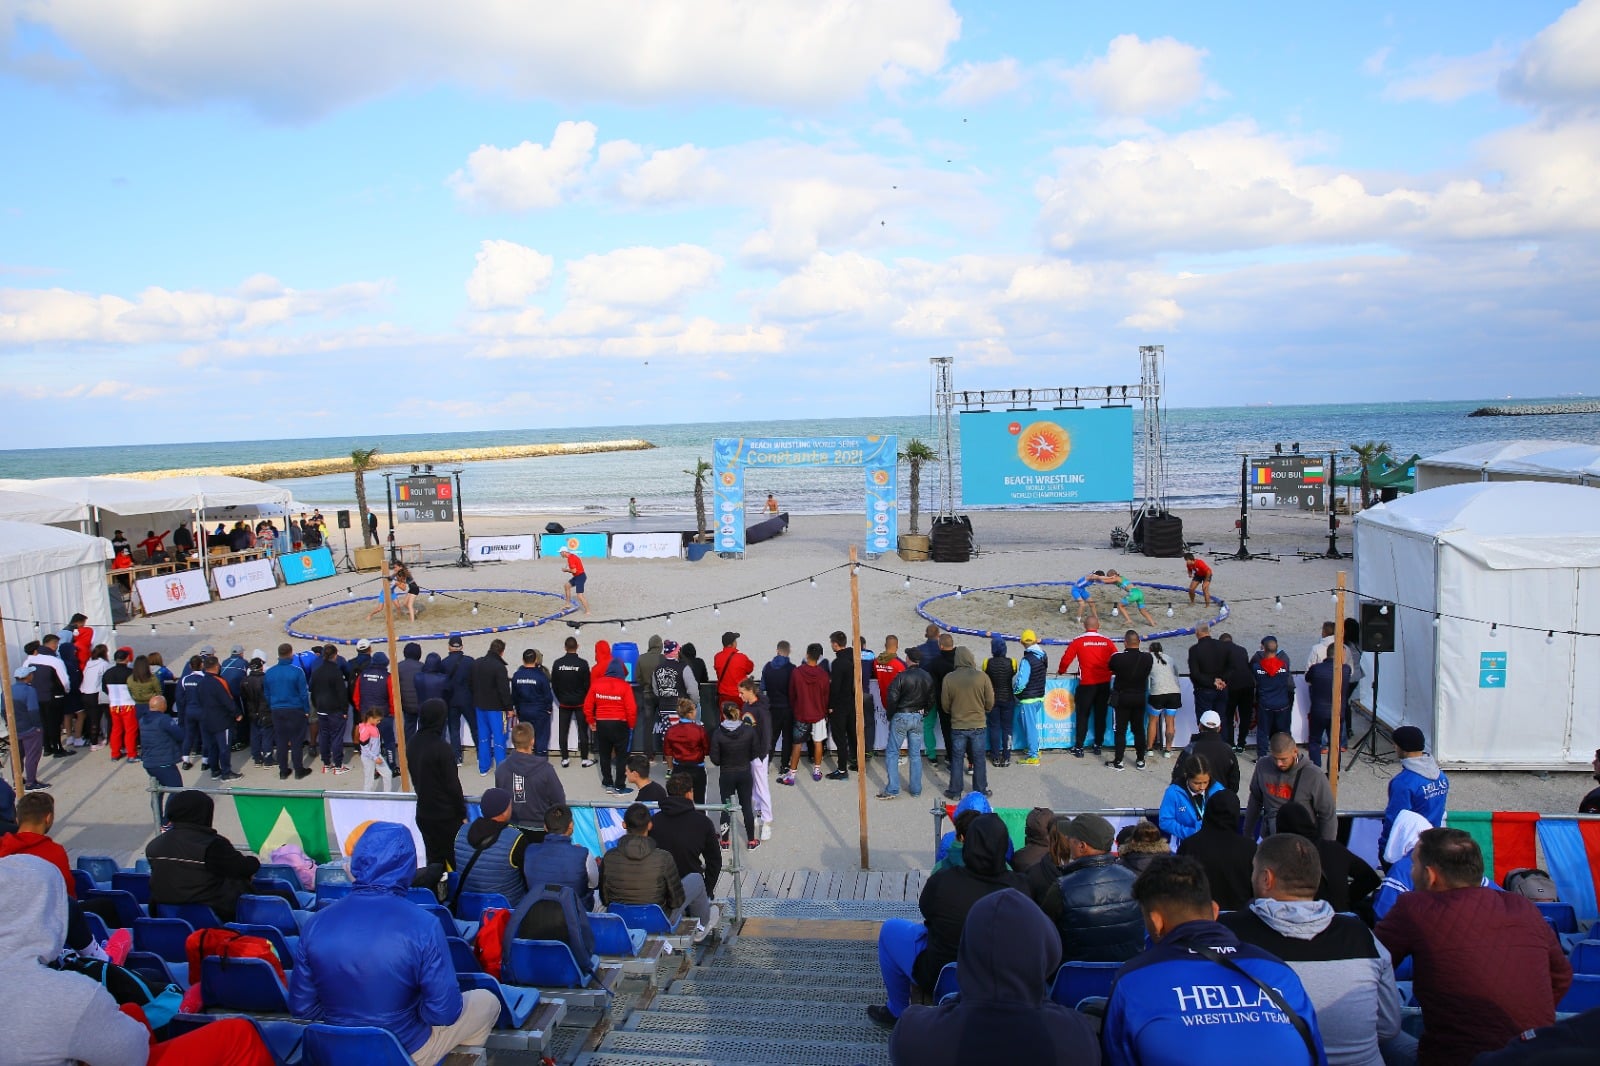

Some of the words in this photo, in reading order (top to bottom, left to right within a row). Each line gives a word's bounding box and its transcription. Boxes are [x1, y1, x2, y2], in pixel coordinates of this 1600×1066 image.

[834, 449, 863, 464] 2021
[1004, 476, 1033, 485] BEACH
[1035, 474, 1085, 484] WRESTLING
[1271, 471, 1286, 479] ROU
[1288, 471, 1302, 479] BUL
[410, 488, 423, 496] ROU
[424, 488, 436, 496] TUR
[1260, 496, 1267, 507] 0
[1276, 495, 1299, 505] 2:49
[1307, 495, 1315, 506] 0
[404, 510, 409, 520] 0
[415, 509, 434, 519] 2:49
[440, 509, 447, 520] 0
[1180, 1012, 1260, 1026] WRESTLING
